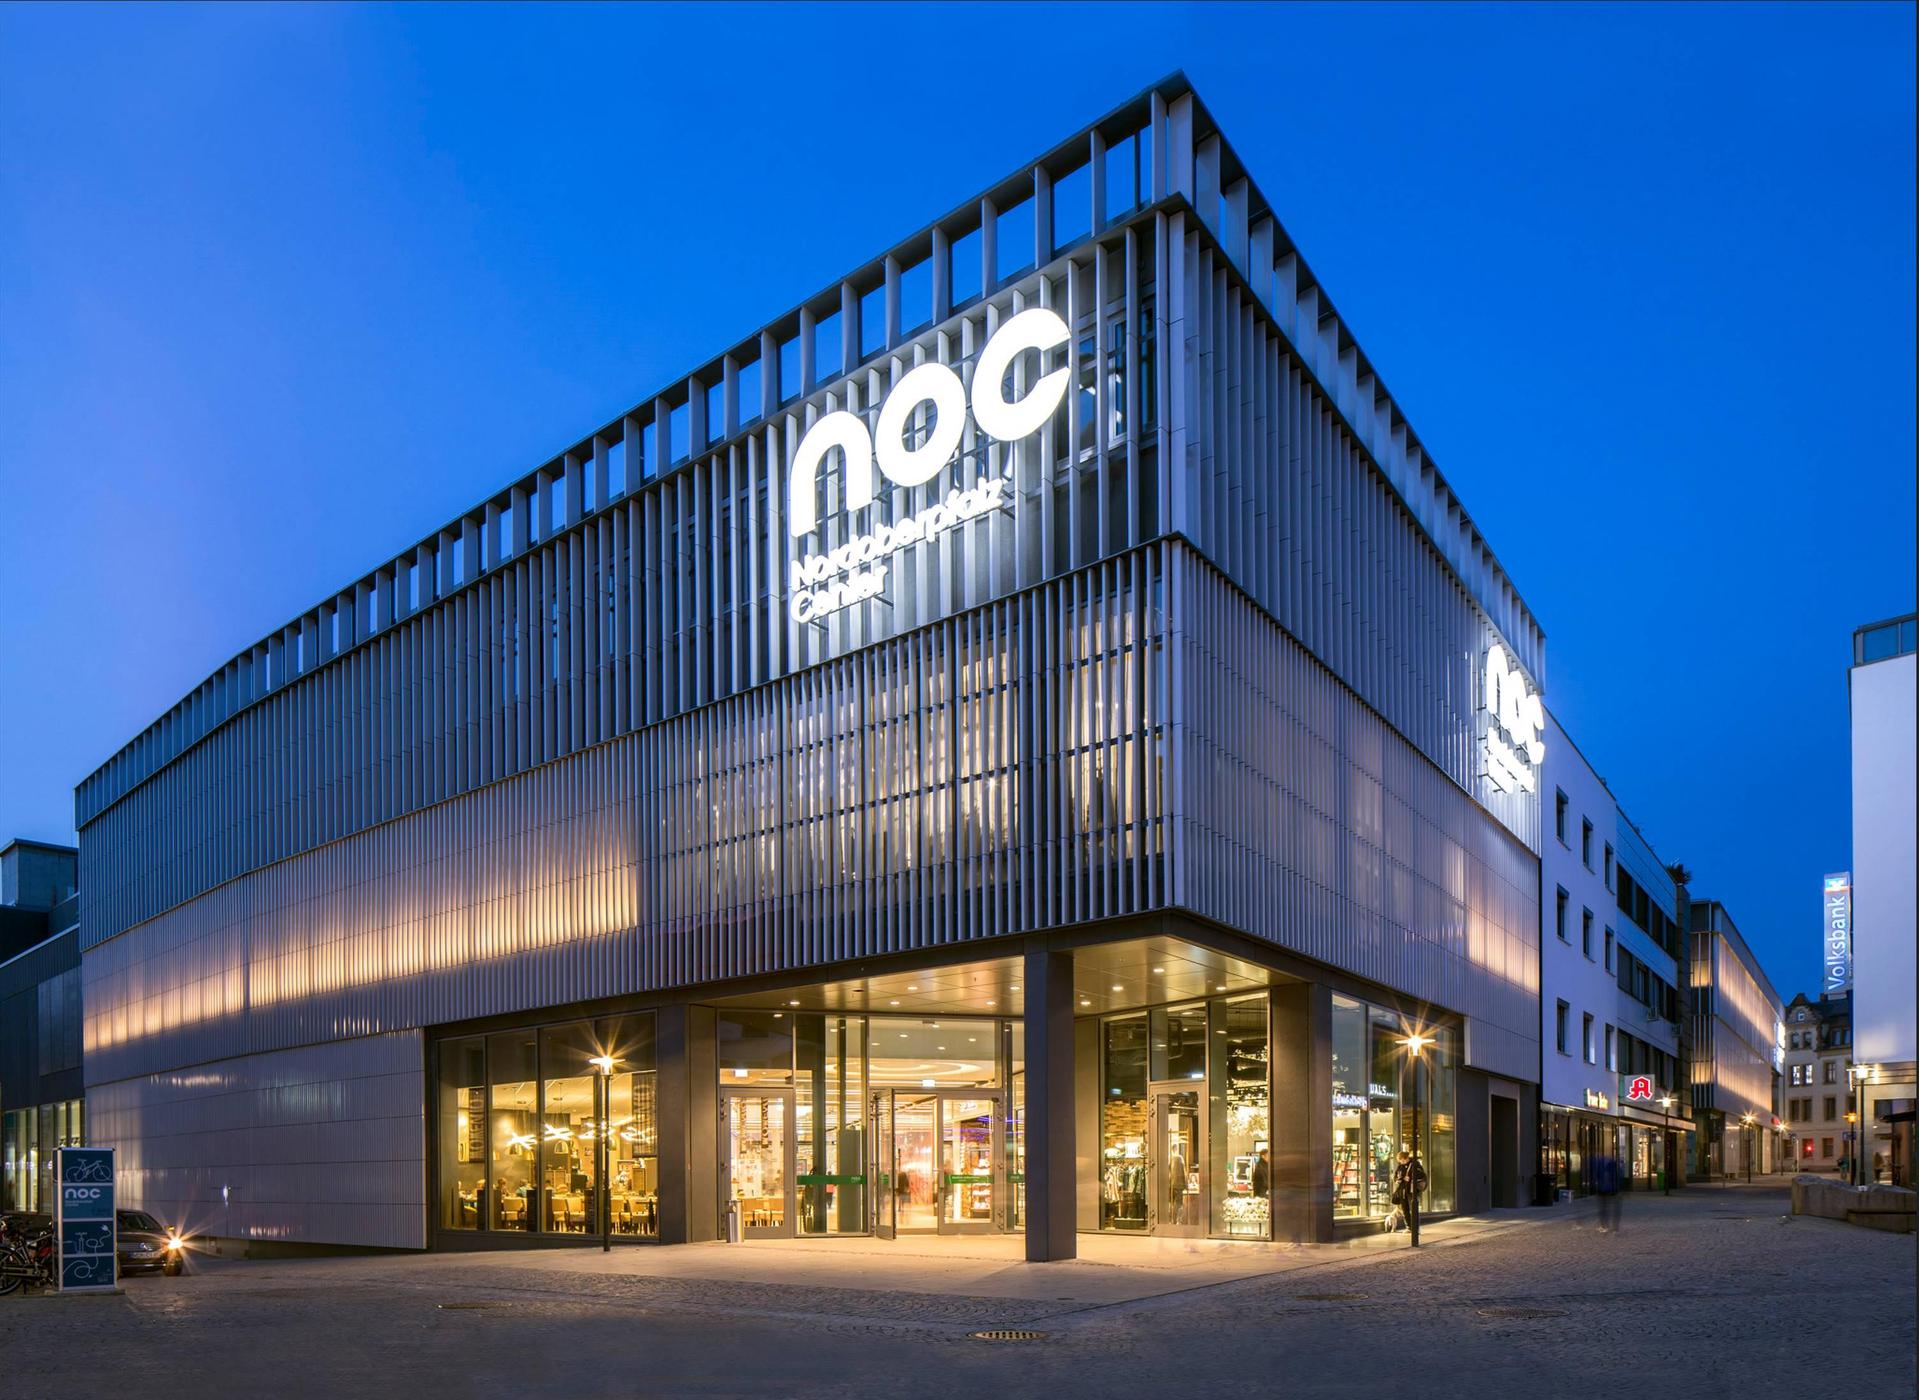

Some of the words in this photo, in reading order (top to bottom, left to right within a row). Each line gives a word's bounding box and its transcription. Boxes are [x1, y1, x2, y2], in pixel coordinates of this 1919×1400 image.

[790, 308, 1071, 537] noc
[790, 565, 888, 623] Center
[1826, 895, 1846, 990] Volksbank
[64, 1188, 101, 1199] noc
